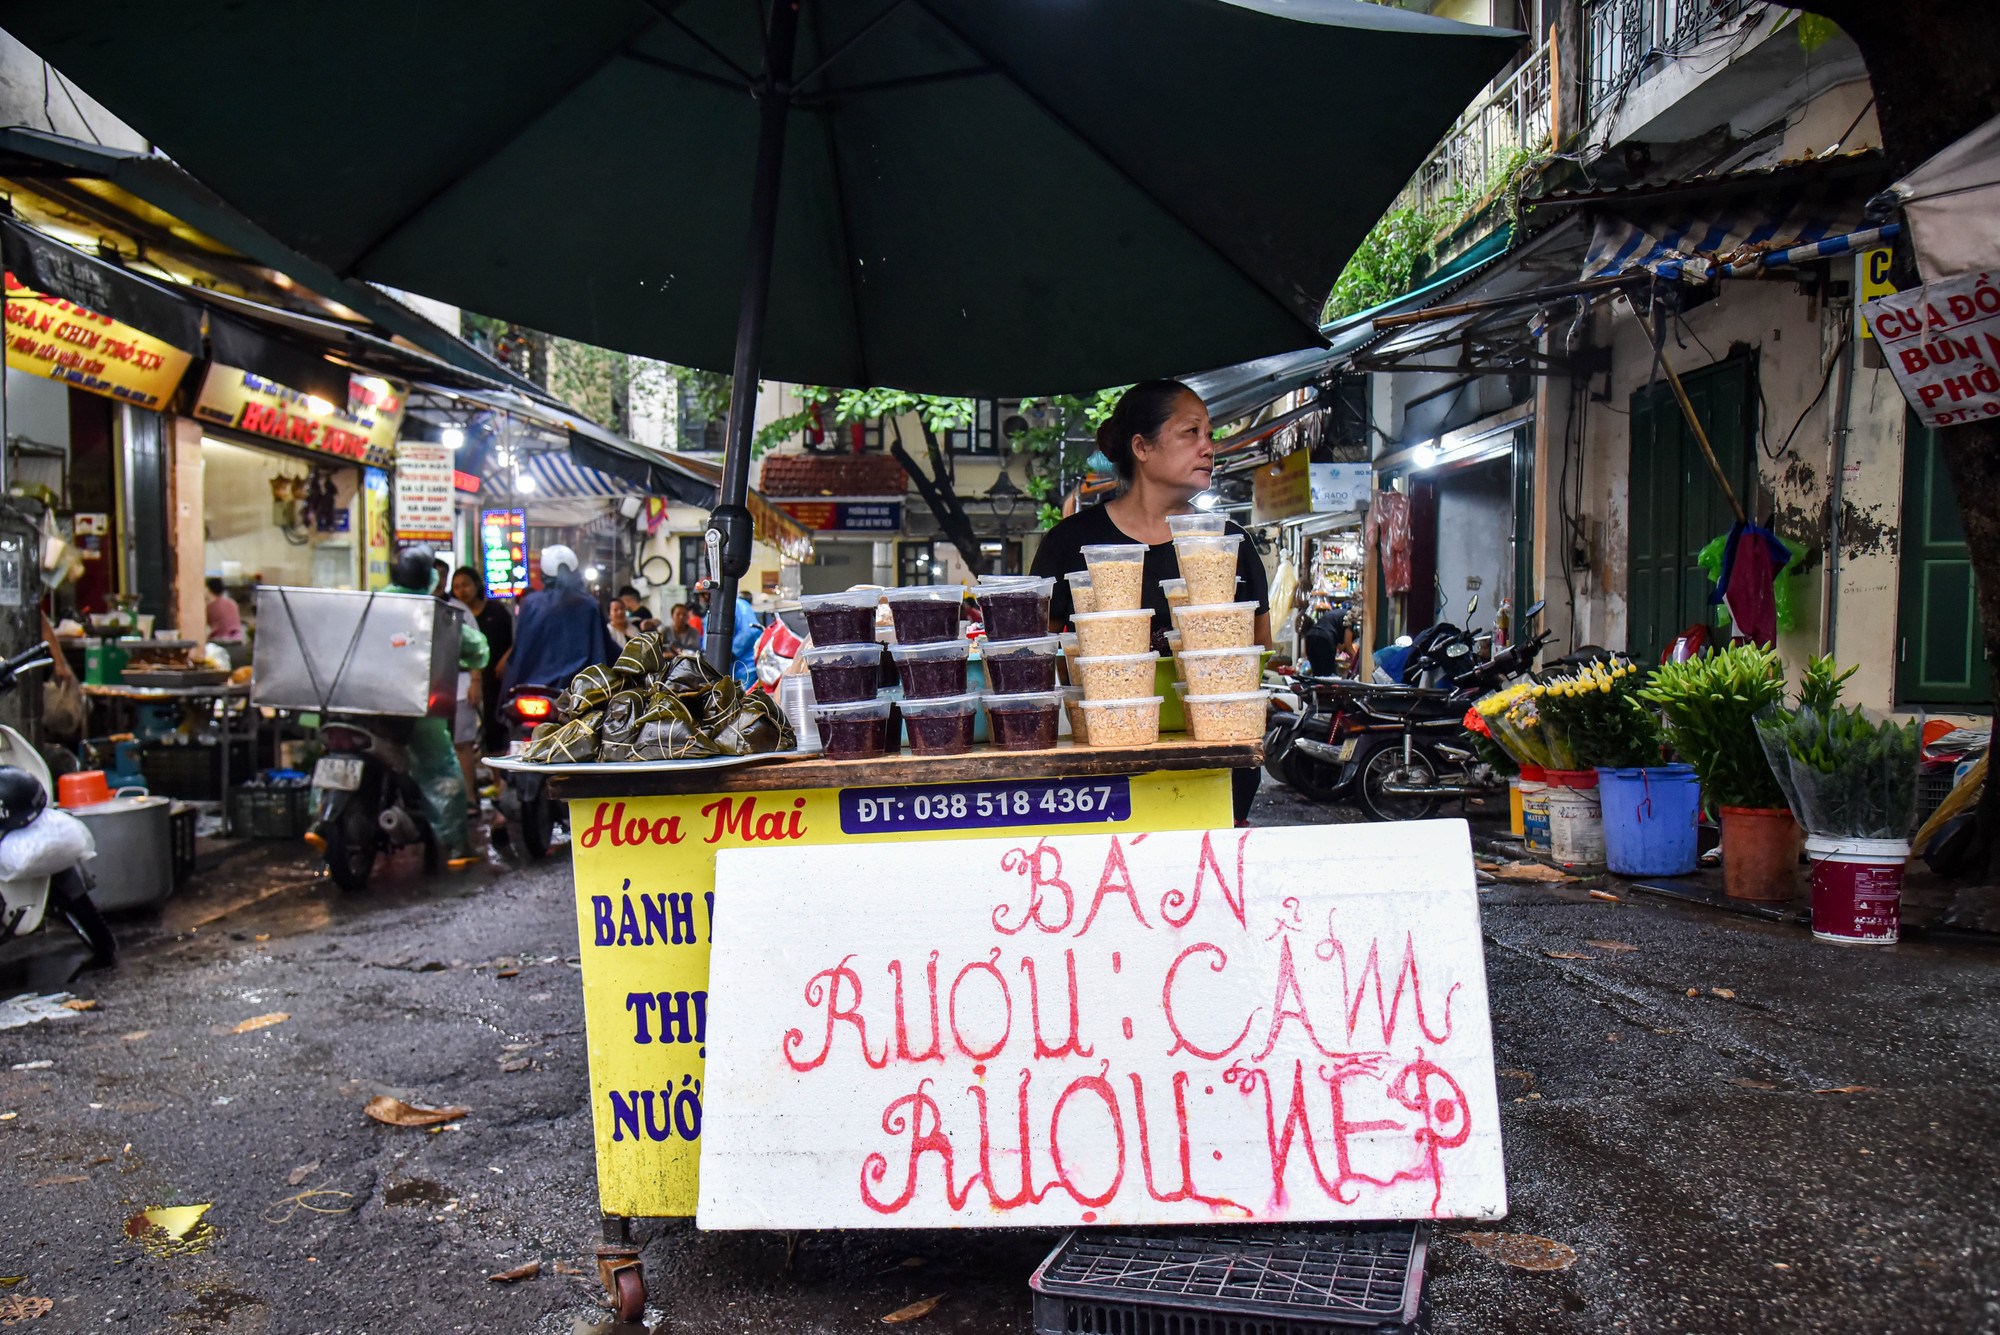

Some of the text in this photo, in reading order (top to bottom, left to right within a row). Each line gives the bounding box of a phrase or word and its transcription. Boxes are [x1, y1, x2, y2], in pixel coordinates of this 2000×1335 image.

[1875, 272, 2000, 339] CUA ĐỒ
[1899, 335, 1983, 376] BÚN
[1324, 492, 1348, 500] RADO
[581, 797, 808, 848] Hoa Mai
[857, 786, 1112, 823] ĐT: 038 518 4367
[591, 878, 697, 947] BÁNH
[992, 828, 1254, 938] BÁN
[609, 1073, 704, 1142] NƯỚ
